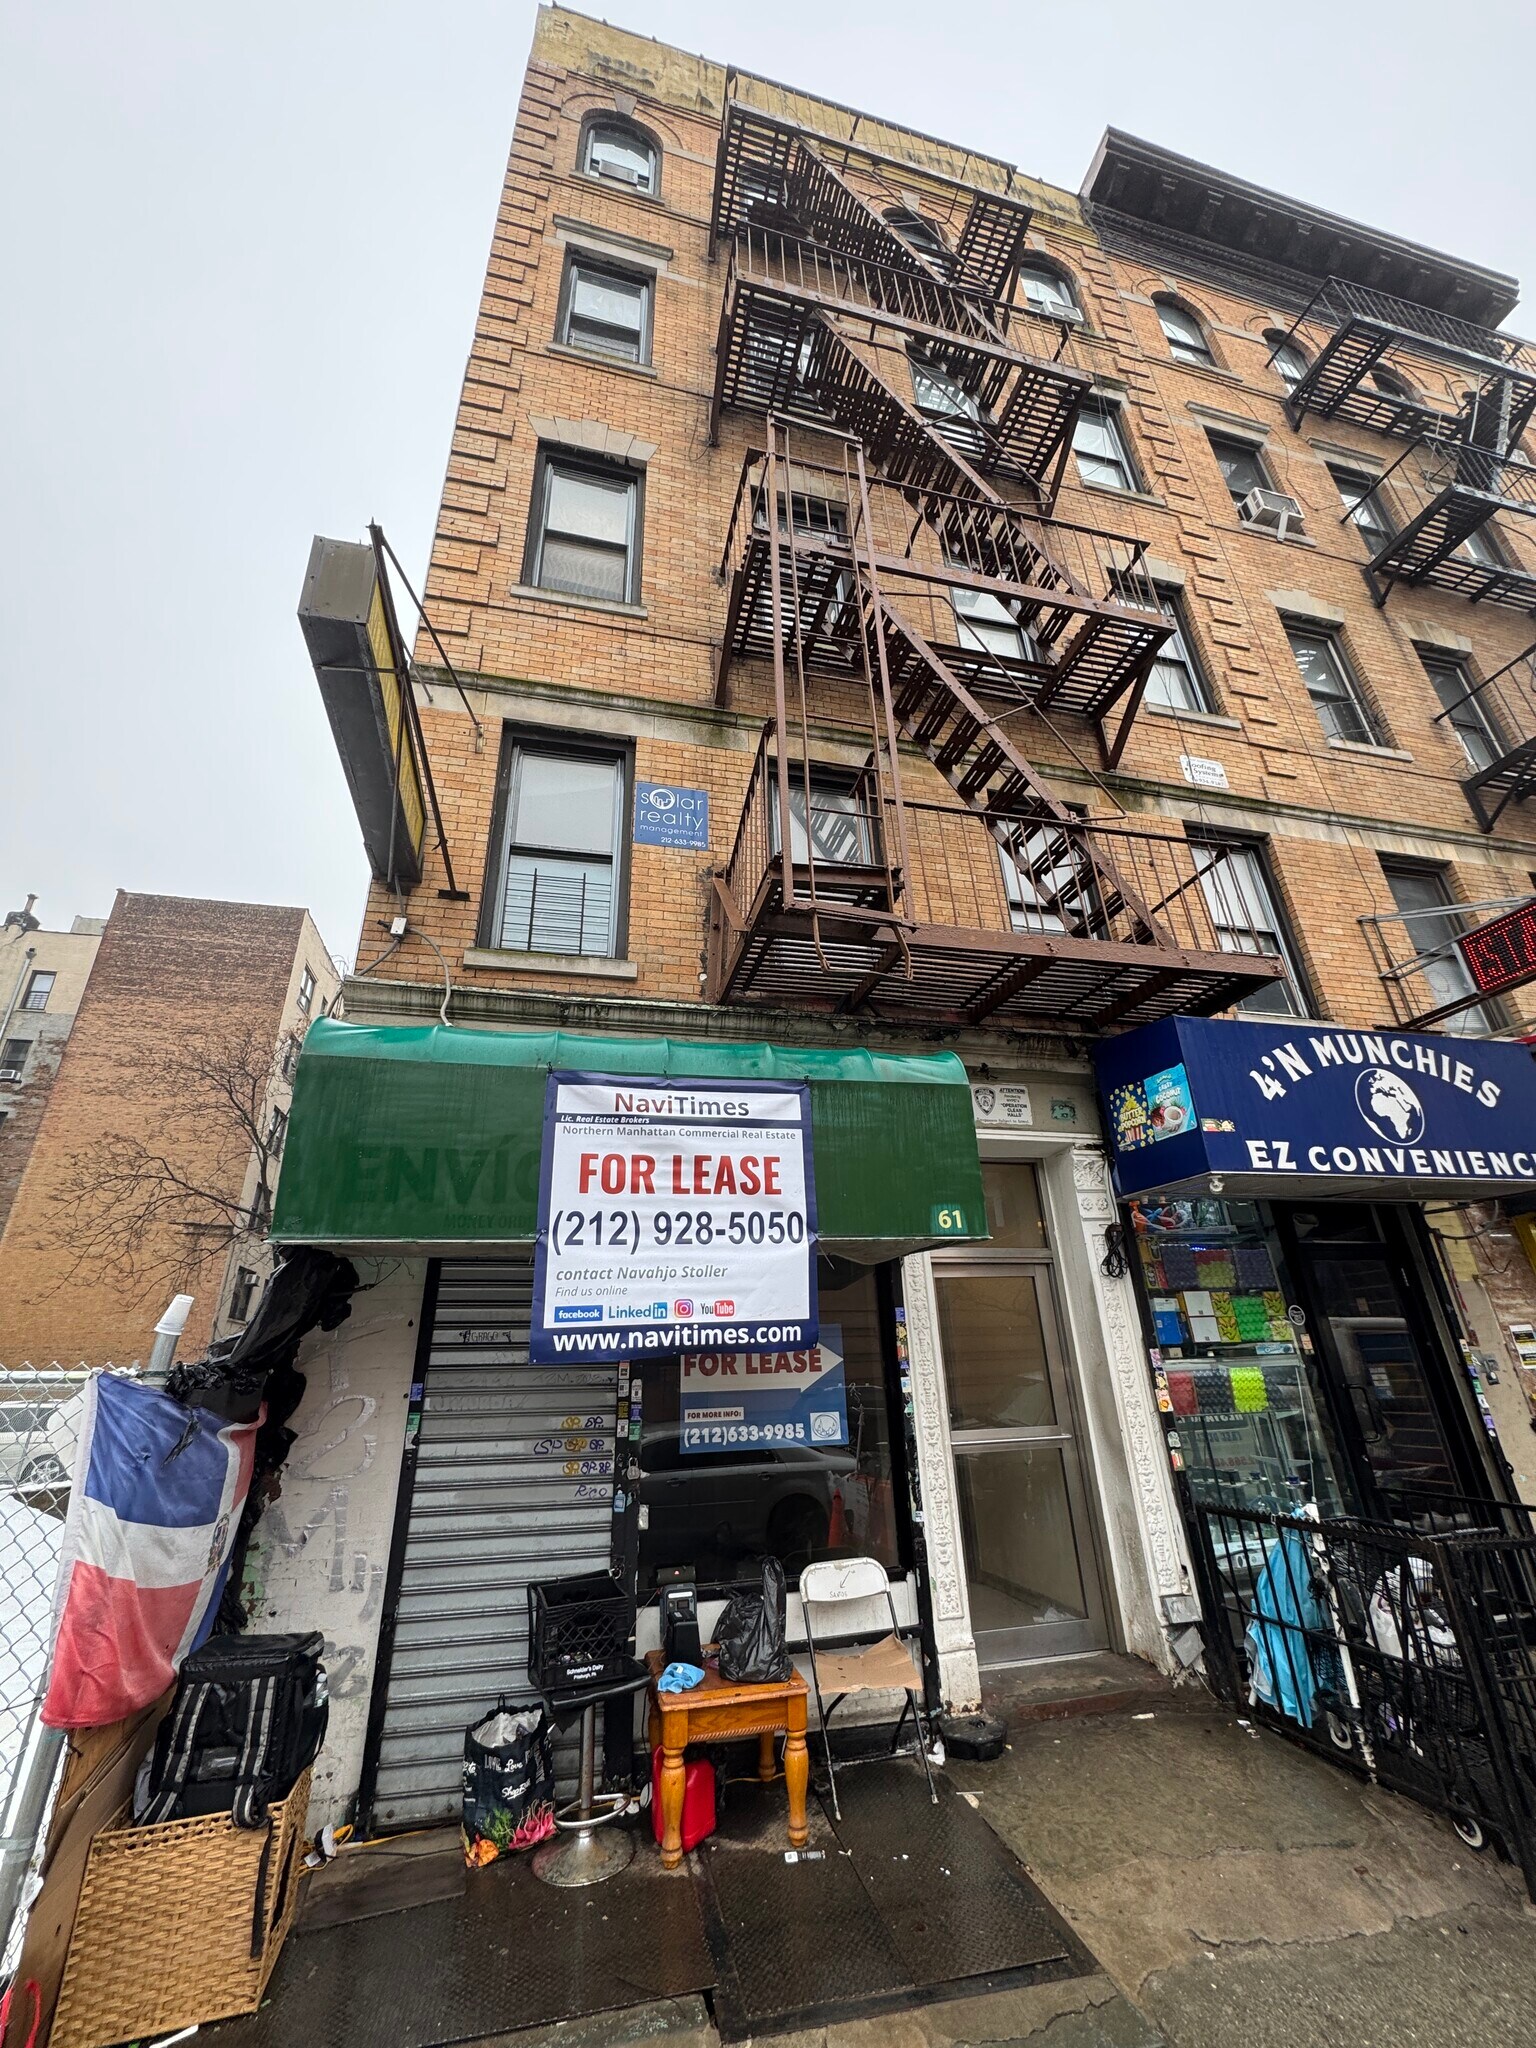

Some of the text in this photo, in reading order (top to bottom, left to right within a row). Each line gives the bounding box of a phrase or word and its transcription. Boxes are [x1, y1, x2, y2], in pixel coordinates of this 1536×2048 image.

[640, 810, 703, 831] realty
[640, 824, 703, 837] management
[1249, 1034, 1501, 1108] 4'N MUNCHIES
[615, 1093, 750, 1116] NaviTimes
[1155, 1087, 1181, 1104] COCONUT
[620, 1116, 650, 1124] Brokers
[1119, 1106, 1144, 1122] BUTTER
[1120, 1115, 1147, 1128] POPCORN
[562, 1125, 796, 1140] Northern Manhattan Commercial Real Estate
[1245, 1140, 1536, 1176] EZ CONVENIENC
[579, 1153, 782, 1196] FOR LEASE
[938, 1209, 963, 1229] 61
[552, 1210, 804, 1256] (212) 928-5050
[556, 1265, 728, 1282] contact Navahjo Stoller
[555, 1285, 628, 1297] Find us online
[558, 1309, 600, 1319] facebook
[553, 1324, 801, 1351] www.navitimes.com
[684, 1349, 822, 1376] FOR LEASE
[723, 1410, 742, 1418] INFO:
[684, 1423, 805, 1448] (212)633-9985
